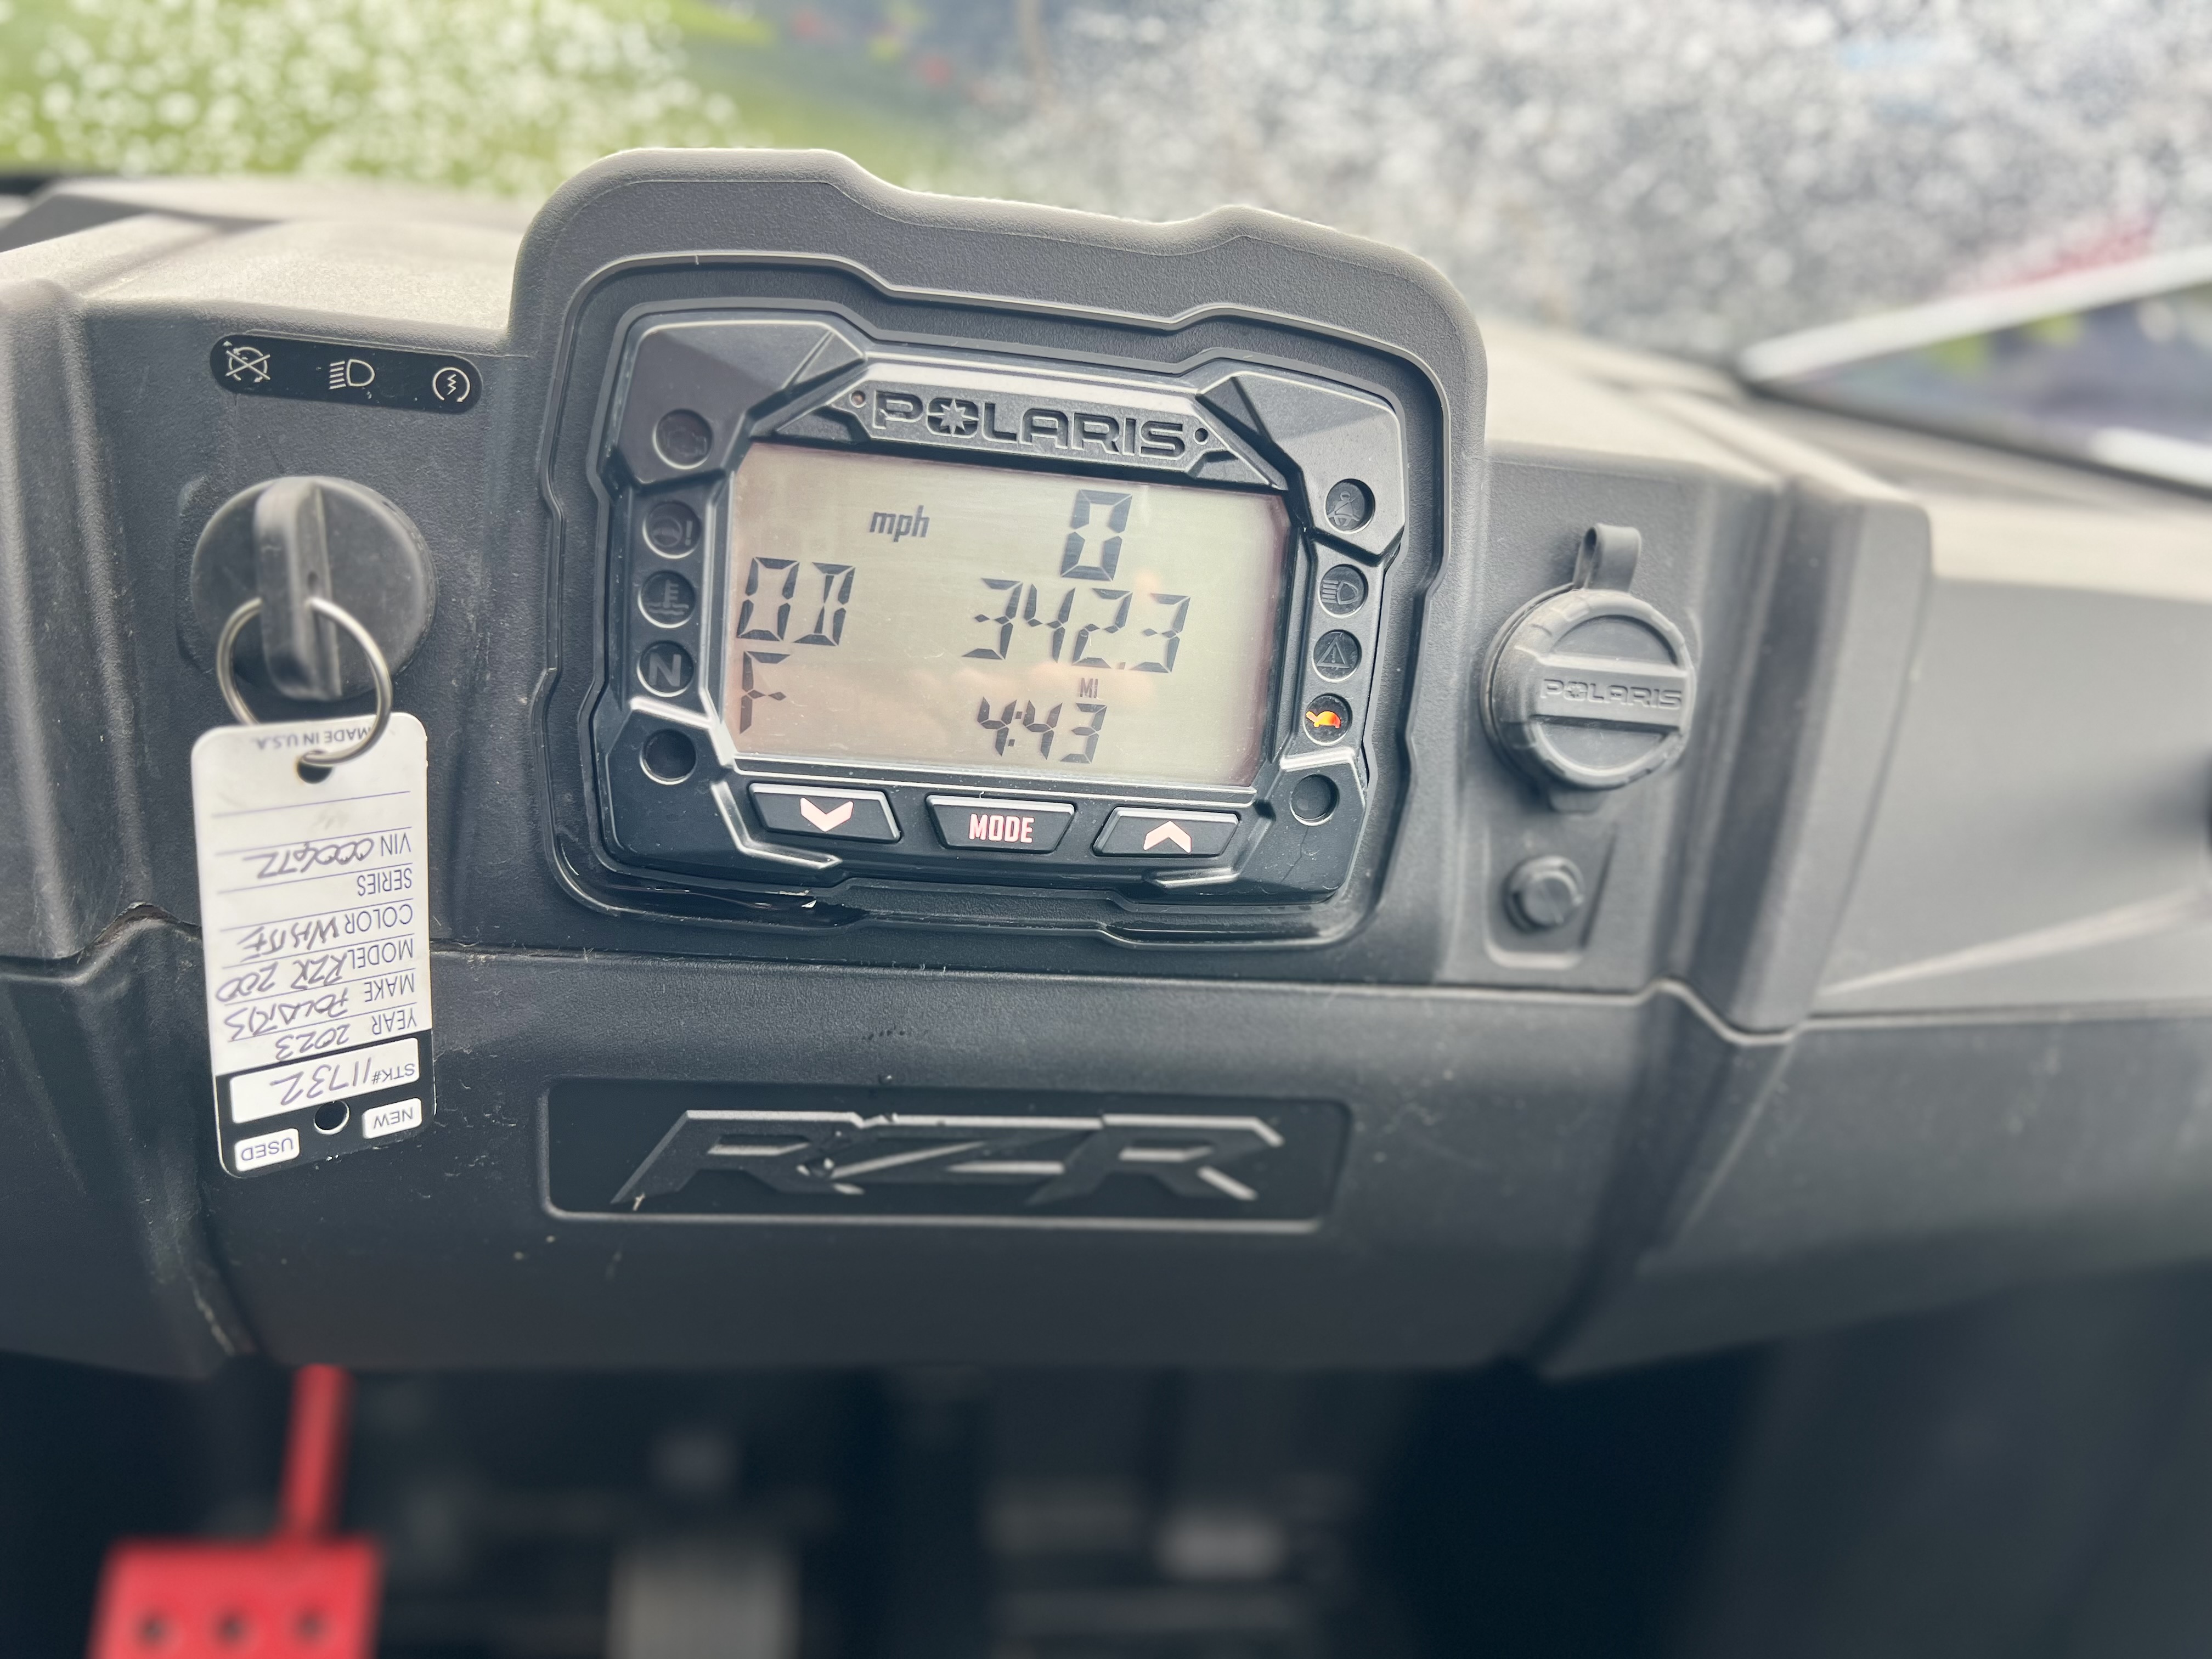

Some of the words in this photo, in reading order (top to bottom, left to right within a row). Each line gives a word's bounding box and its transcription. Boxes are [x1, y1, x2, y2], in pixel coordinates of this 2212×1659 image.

[872, 390, 1186, 459] POLARIS
[869, 505, 930, 543] mph
[1060, 489, 1132, 582] 0
[962, 577, 1190, 673] 342.3
[740, 651, 791, 734] F
[1079, 678, 1098, 698] MI
[1541, 679, 1682, 709] POLARIS
[303, 732, 319, 744] IN
[324, 726, 371, 743] MADE
[977, 696, 1108, 764] 4:43
[969, 814, 1035, 843] MODE
[380, 832, 411, 856] VIN
[357, 867, 412, 896] SERIES
[344, 904, 413, 934] COLOR
[347, 938, 413, 969] MODEL
[215, 961, 279, 1002] 200
[364, 973, 415, 1002] MAKE
[224, 988, 349, 1041] POLARIS
[371, 1007, 417, 1035] YEAR
[275, 1024, 351, 1062] 2023
[269, 1057, 372, 1106] 11732
[371, 1063, 415, 1085] STK#
[373, 1107, 413, 1129] NEW
[240, 1137, 294, 1161] USED
[609, 1109, 1284, 1204] RZR
